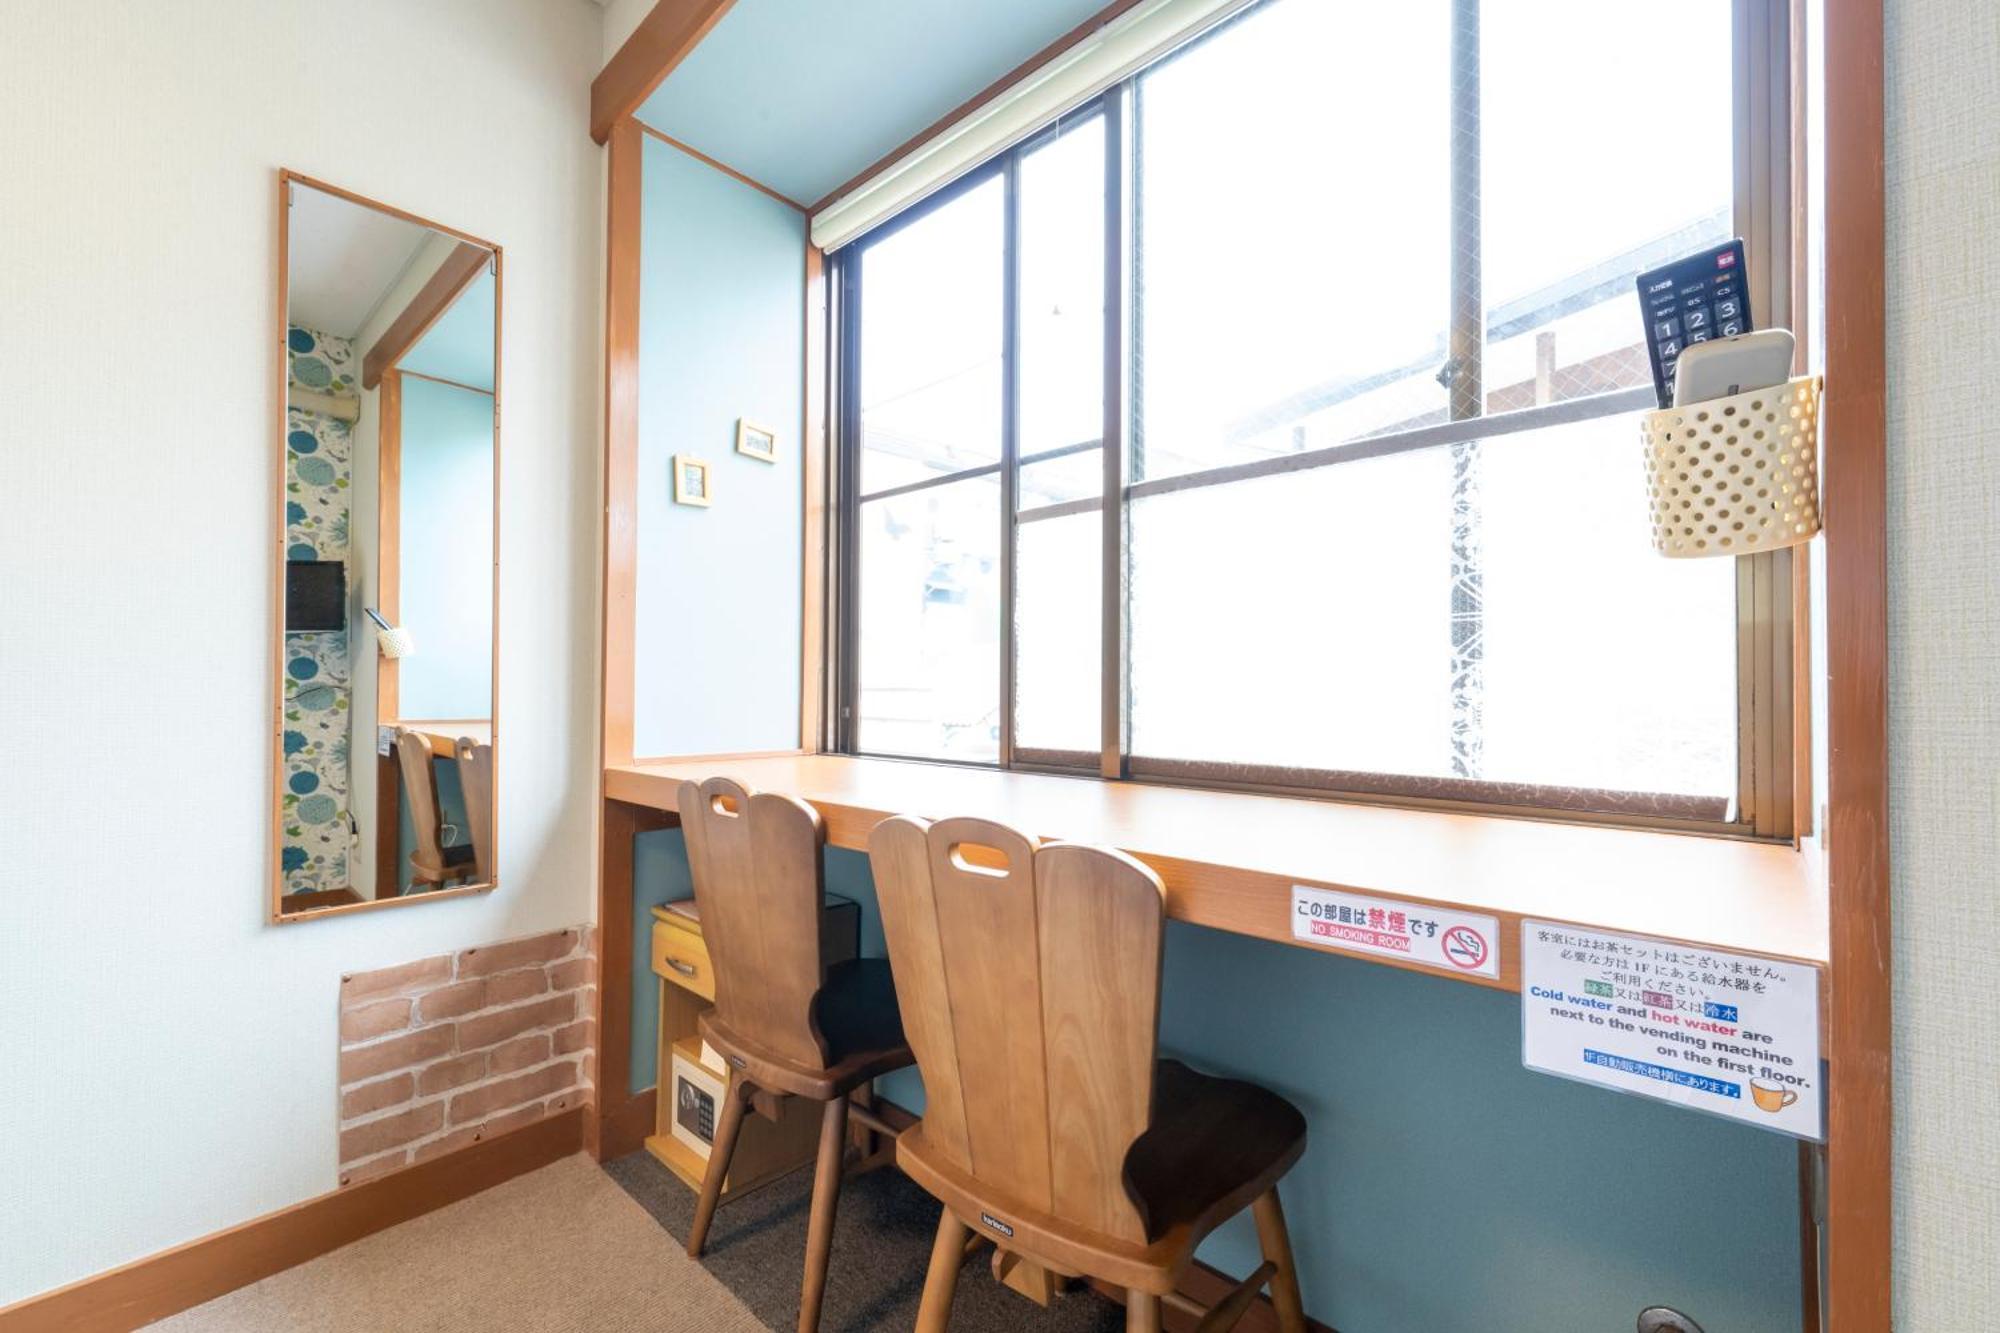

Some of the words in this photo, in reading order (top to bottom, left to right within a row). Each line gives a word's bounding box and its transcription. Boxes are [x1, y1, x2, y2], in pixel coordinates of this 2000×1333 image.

[1691, 312, 1704, 329] 2
[1721, 302, 1736, 318] 3
[1662, 323, 1671, 337] 1
[1694, 331, 1707, 342] 5
[1723, 322, 1738, 337] 6
[1664, 342, 1678, 355] 4
[1298, 899, 1439, 938] この部屋は禁煙です
[1311, 922, 1326, 935] NO
[1329, 925, 1374, 945] SMOKING
[1378, 935, 1410, 950] ROOM
[1600, 970, 1711, 1001] ご利用ください。
[1530, 986, 1564, 1001] Cold
[1567, 994, 1613, 1011] water
[1617, 1005, 1647, 1018] and
[1651, 1010, 1680, 1026] hot
[1685, 1018, 1738, 1036] water
[1742, 1030, 1773, 1044] are
[1550, 1007, 1584, 1021] next
[1588, 1013, 1605, 1026] to
[1609, 1016, 1635, 1032] the
[1639, 1027, 1707, 1049] vending
[1712, 1040, 1794, 1066] machine
[1657, 1045, 1678, 1058] on
[1683, 1050, 1713, 1065] the
[1717, 1058, 1754, 1075] first
[1760, 1066, 1811, 1088] floor.
